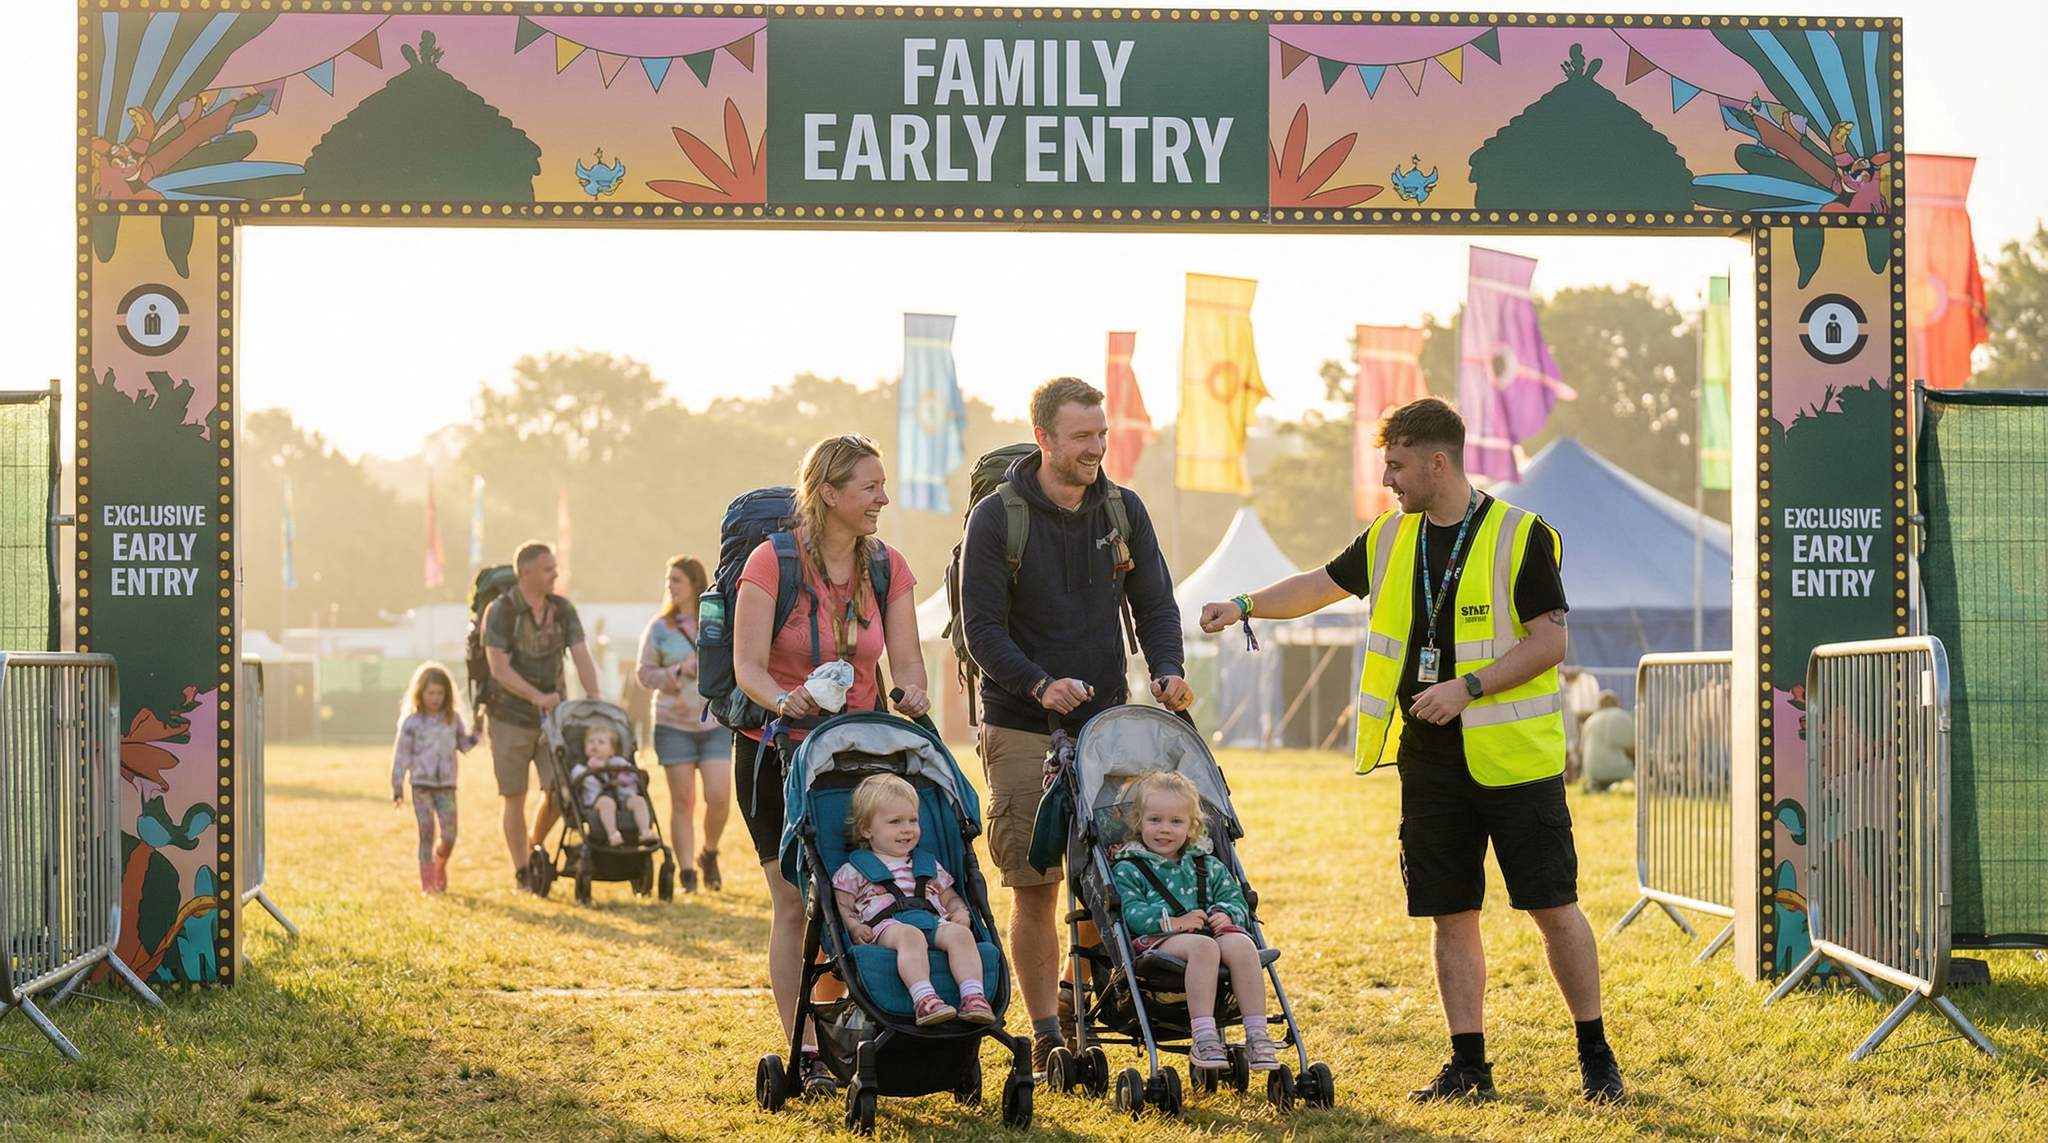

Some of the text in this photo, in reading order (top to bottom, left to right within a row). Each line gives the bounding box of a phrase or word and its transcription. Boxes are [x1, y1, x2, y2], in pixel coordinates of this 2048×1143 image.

[904, 38, 1135, 106] FAMILY
[805, 114, 1233, 183] EARLY ENTRY
[104, 505, 205, 526] EXCLUSIVE
[1785, 508, 1881, 528] EXCLUSIVE
[113, 533, 197, 560] EARLY
[1794, 535, 1872, 562] EARLY
[112, 568, 199, 595] ENTRY
[1792, 570, 1874, 596] ENTRY
